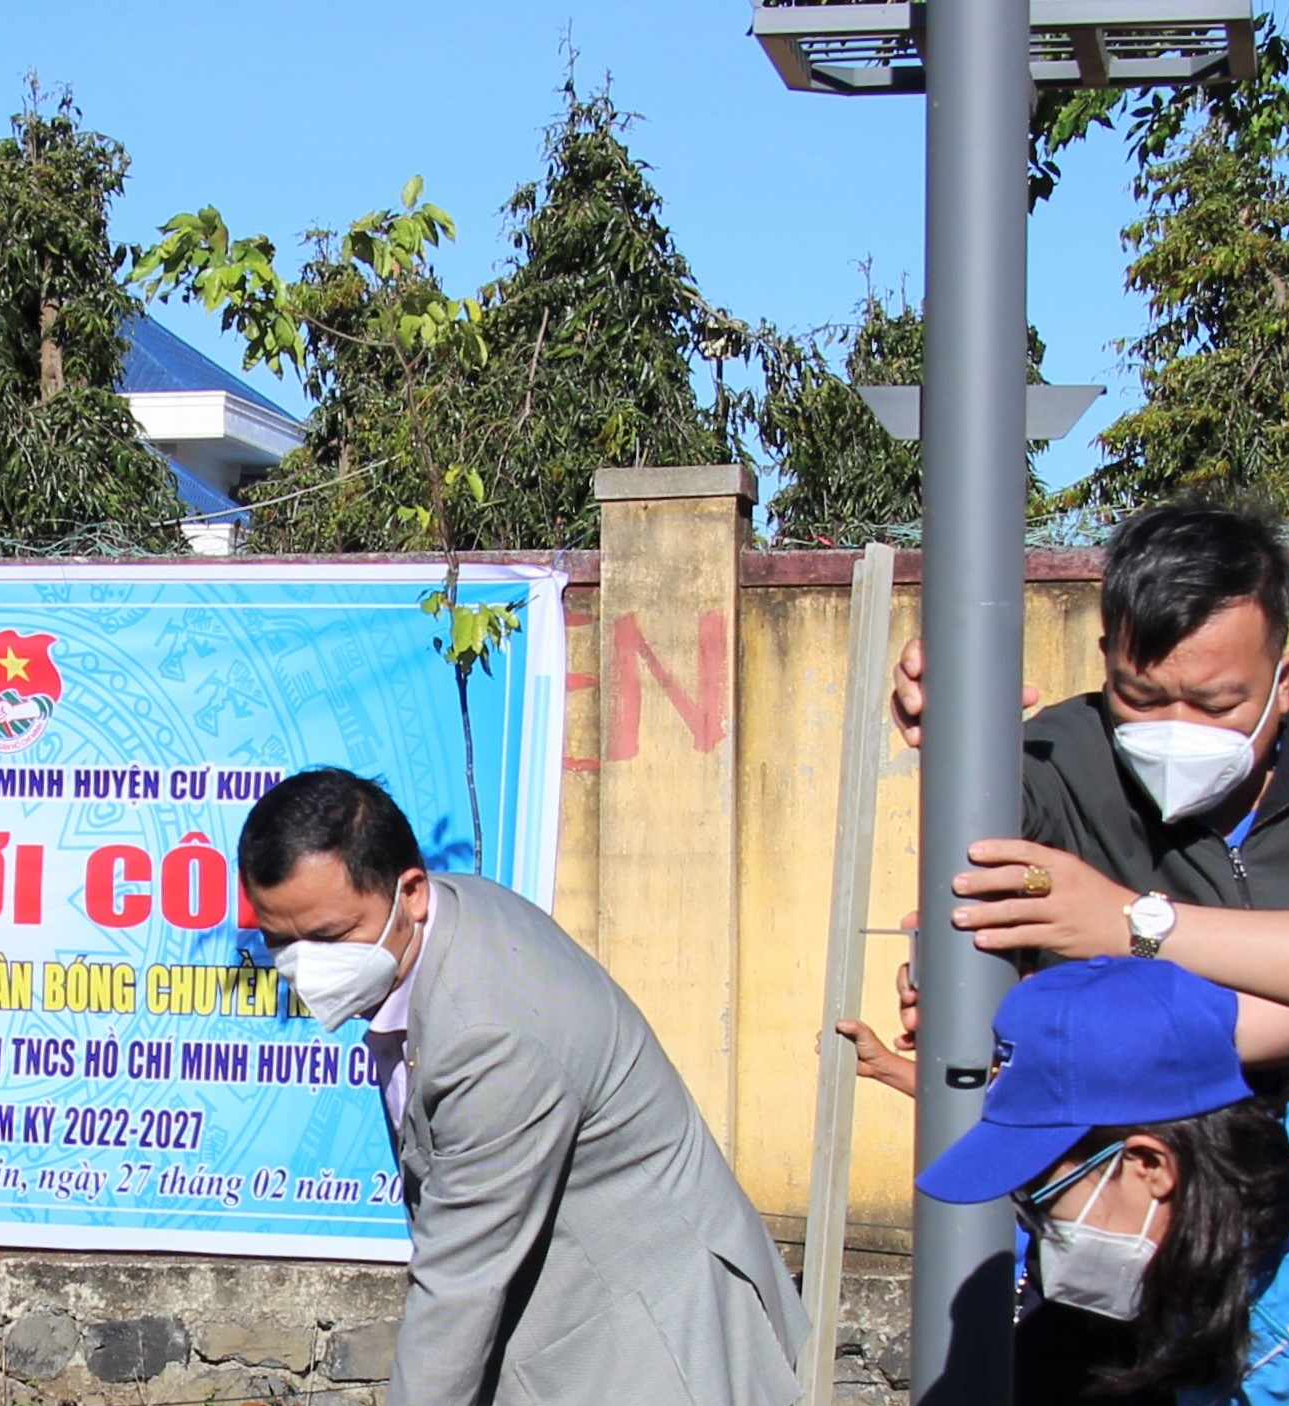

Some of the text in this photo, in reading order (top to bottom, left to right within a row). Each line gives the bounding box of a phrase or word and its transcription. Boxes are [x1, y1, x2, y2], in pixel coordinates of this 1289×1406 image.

[74, 765, 159, 805] HUYỆN
[171, 766, 211, 800] CƯ
[217, 771, 280, 800] KUIN
[42, 955, 136, 1014] BÓNG
[146, 949, 278, 1017] CHUYỀN
[11, 1037, 76, 1077] TNCS
[84, 1026, 119, 1079] HỒ
[127, 1035, 173, 1080] CHÍ
[180, 1042, 249, 1083] MINH
[257, 1038, 340, 1093] HUYỆN
[23, 1099, 56, 1144] KỲ
[63, 1107, 203, 1150] 2022-2027
[38, 1161, 107, 1201] ngày
[116, 1163, 152, 1194] 27
[159, 1165, 243, 1207] tháng
[253, 1168, 287, 1199] 02
[296, 1169, 360, 1202] năm
